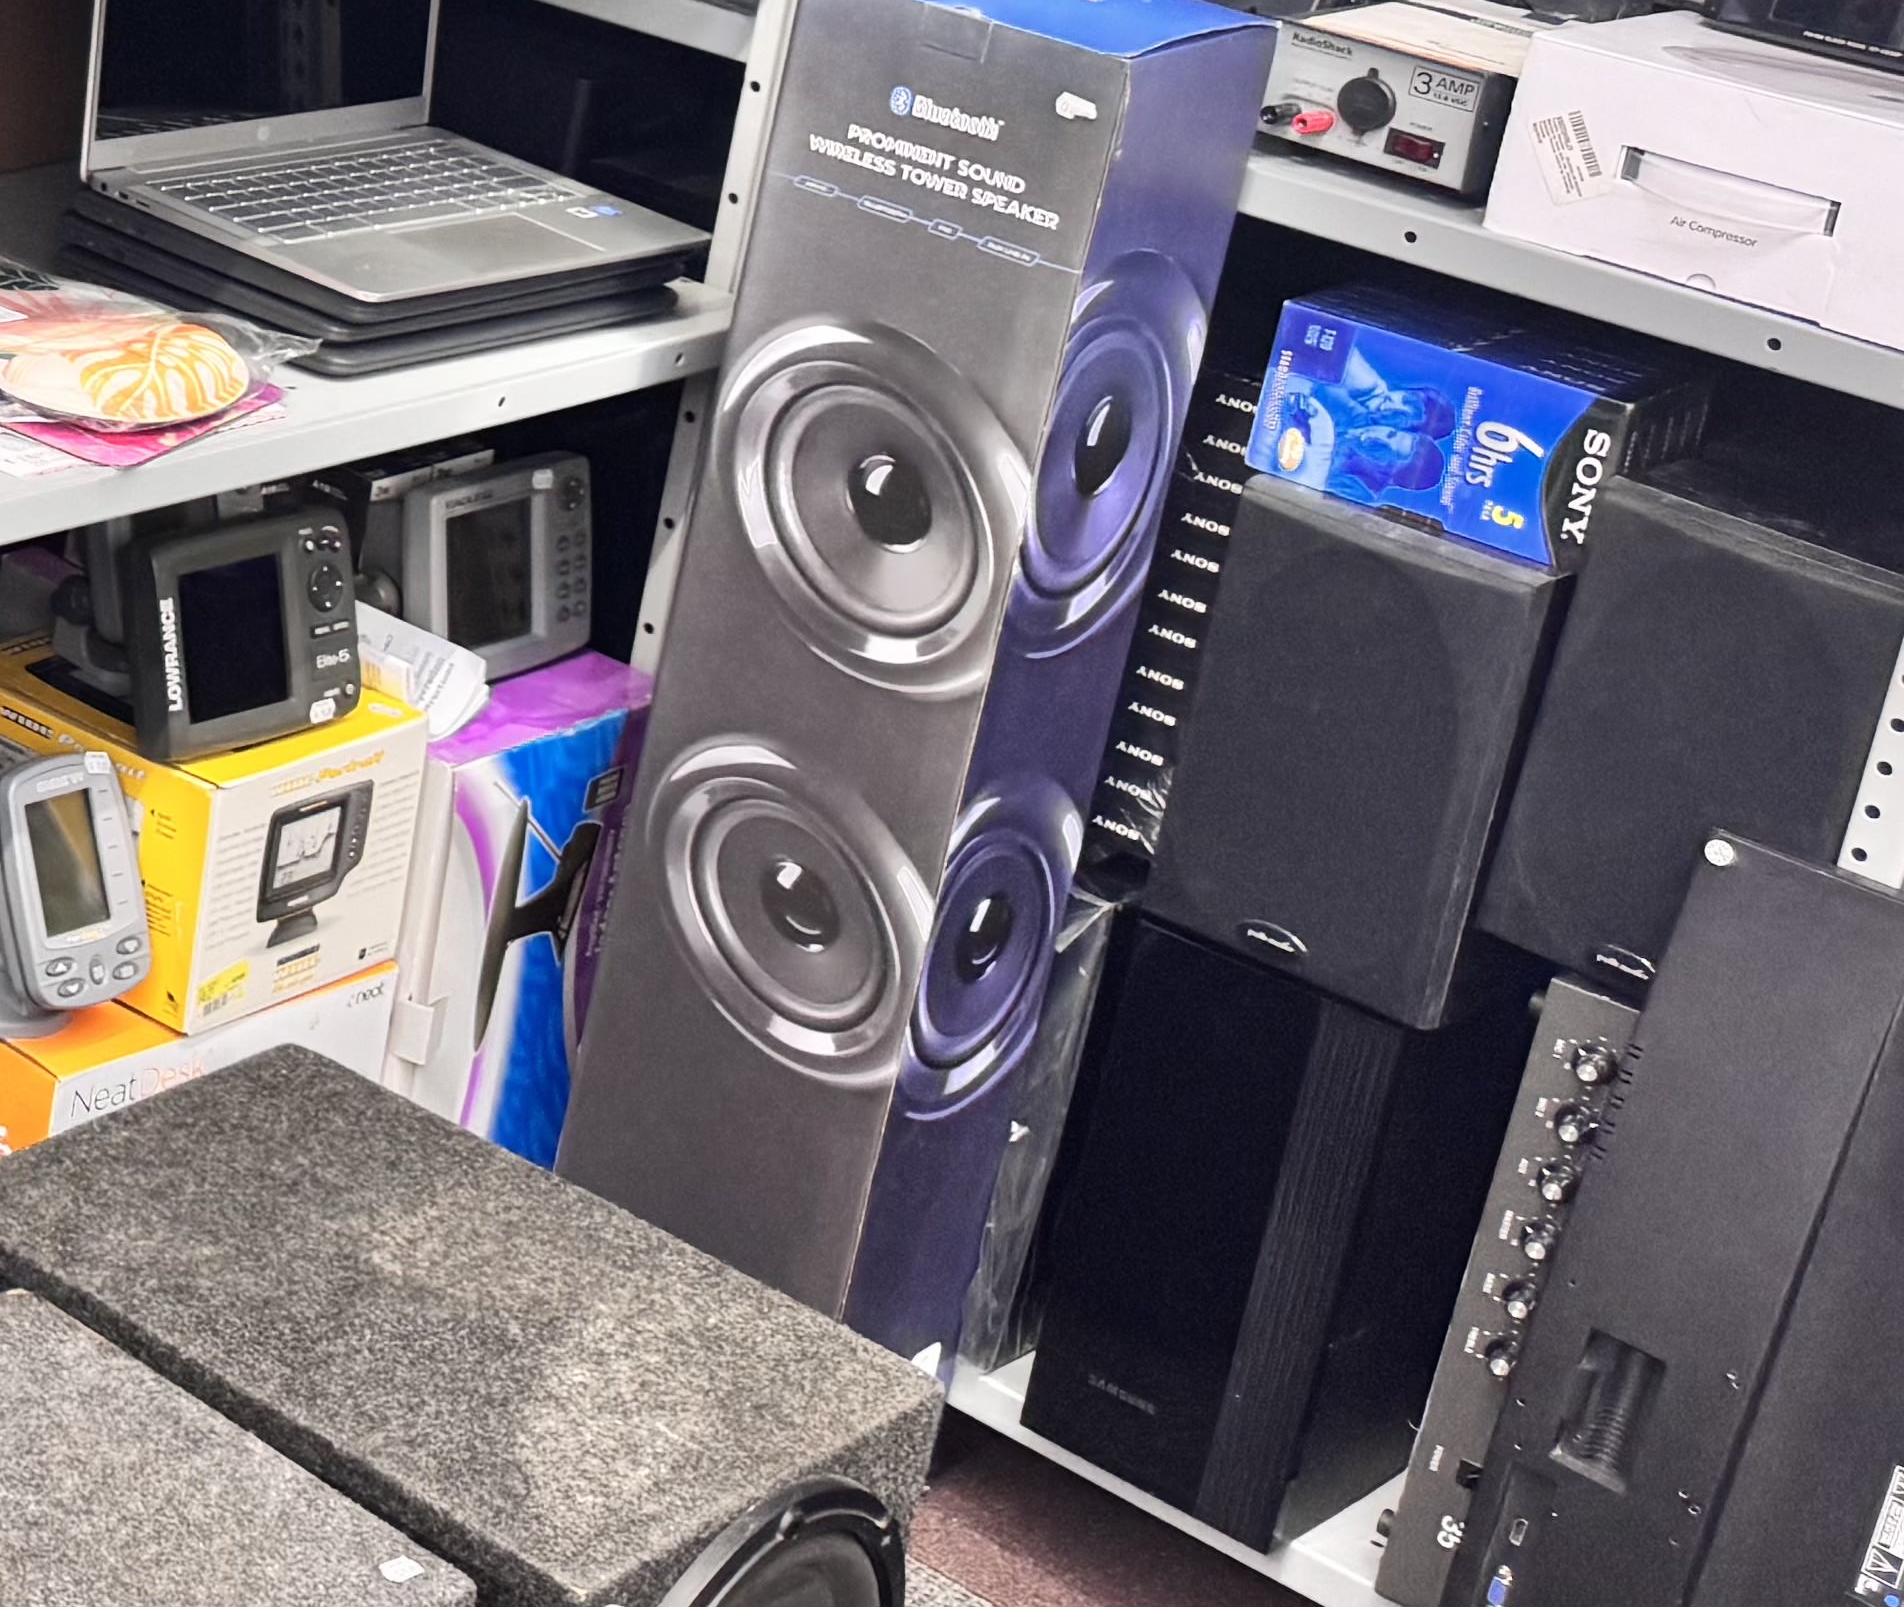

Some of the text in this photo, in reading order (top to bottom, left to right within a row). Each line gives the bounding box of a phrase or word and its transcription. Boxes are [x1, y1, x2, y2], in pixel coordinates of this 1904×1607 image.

[1292, 31, 1353, 56] RadioShack
[1413, 71, 1476, 96] 3 AMP
[847, 123, 1026, 194] PROMINENT SOUND
[809, 133, 1060, 230] WIRELESS TOWER SPEAKER
[1670, 214, 1759, 248] Air Compressor
[1194, 471, 1243, 494] SONY
[1561, 429, 1612, 545] SONY
[1181, 512, 1230, 537] SONY
[1170, 549, 1220, 573] SONY
[1157, 588, 1207, 614] SONY
[1147, 624, 1197, 650] SONY
[159, 596, 183, 712] LOWRANCE
[1135, 665, 1185, 691] SONY
[1127, 701, 1176, 727] SONY
[1115, 741, 1164, 767] SONY
[1092, 814, 1141, 841] SONY
